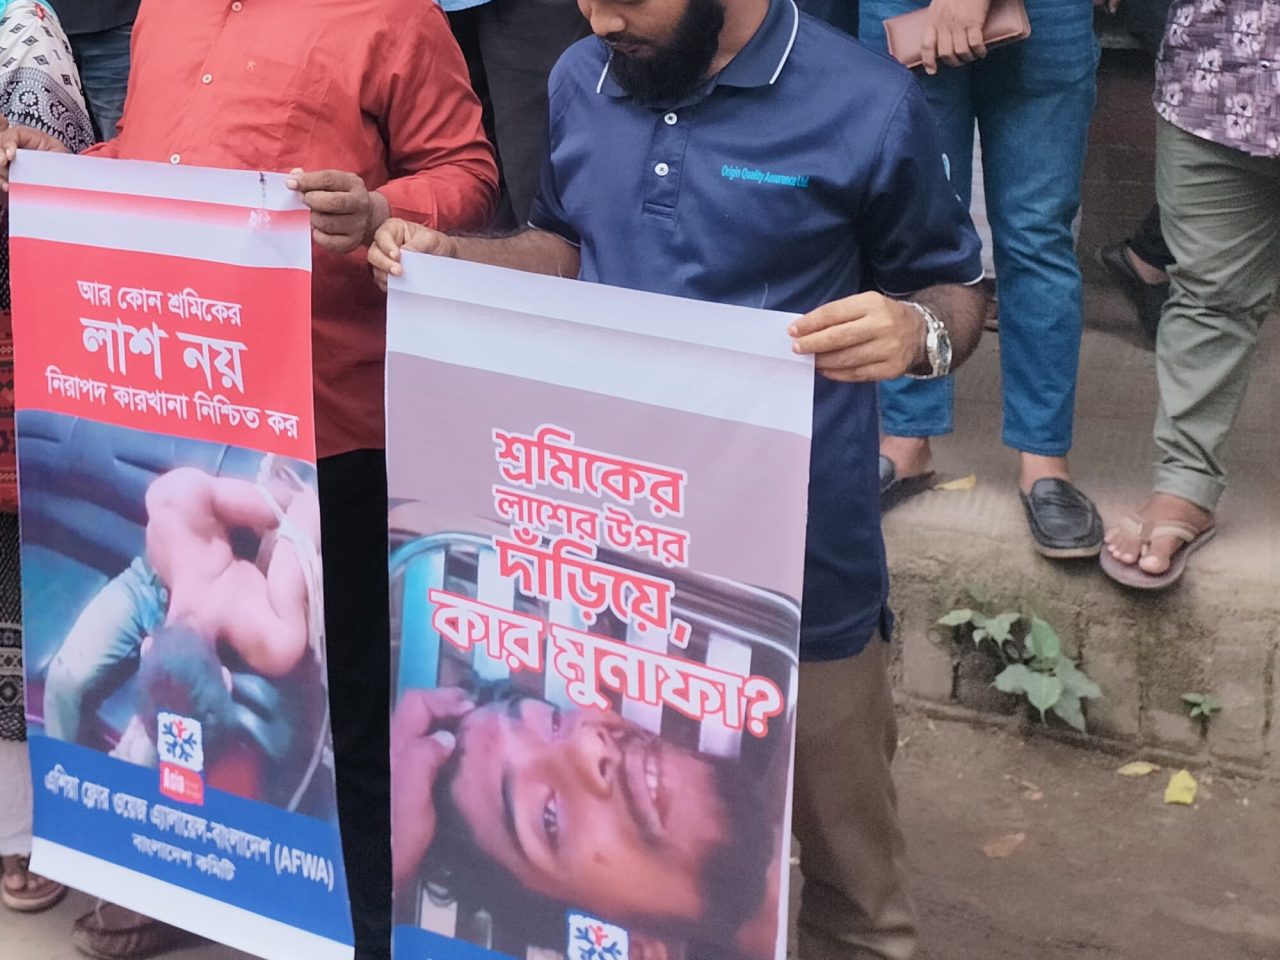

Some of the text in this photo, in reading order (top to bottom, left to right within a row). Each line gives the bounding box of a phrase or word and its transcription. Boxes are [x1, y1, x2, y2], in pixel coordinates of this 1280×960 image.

[76, 280, 242, 328] আর কোন শ্রমিকের
[79, 316, 249, 395] লাশ নয়
[45, 365, 300, 440] নিরাপদ কারখানা নিশ্চিত কর
[493, 424, 686, 516] শ্রমিকের
[493, 486, 690, 567] লাশের উপর
[493, 526, 692, 648] দাঁড়িয়ে,
[428, 588, 784, 737] কার মুনাফা?
[274, 843, 335, 892] (AFWA)
